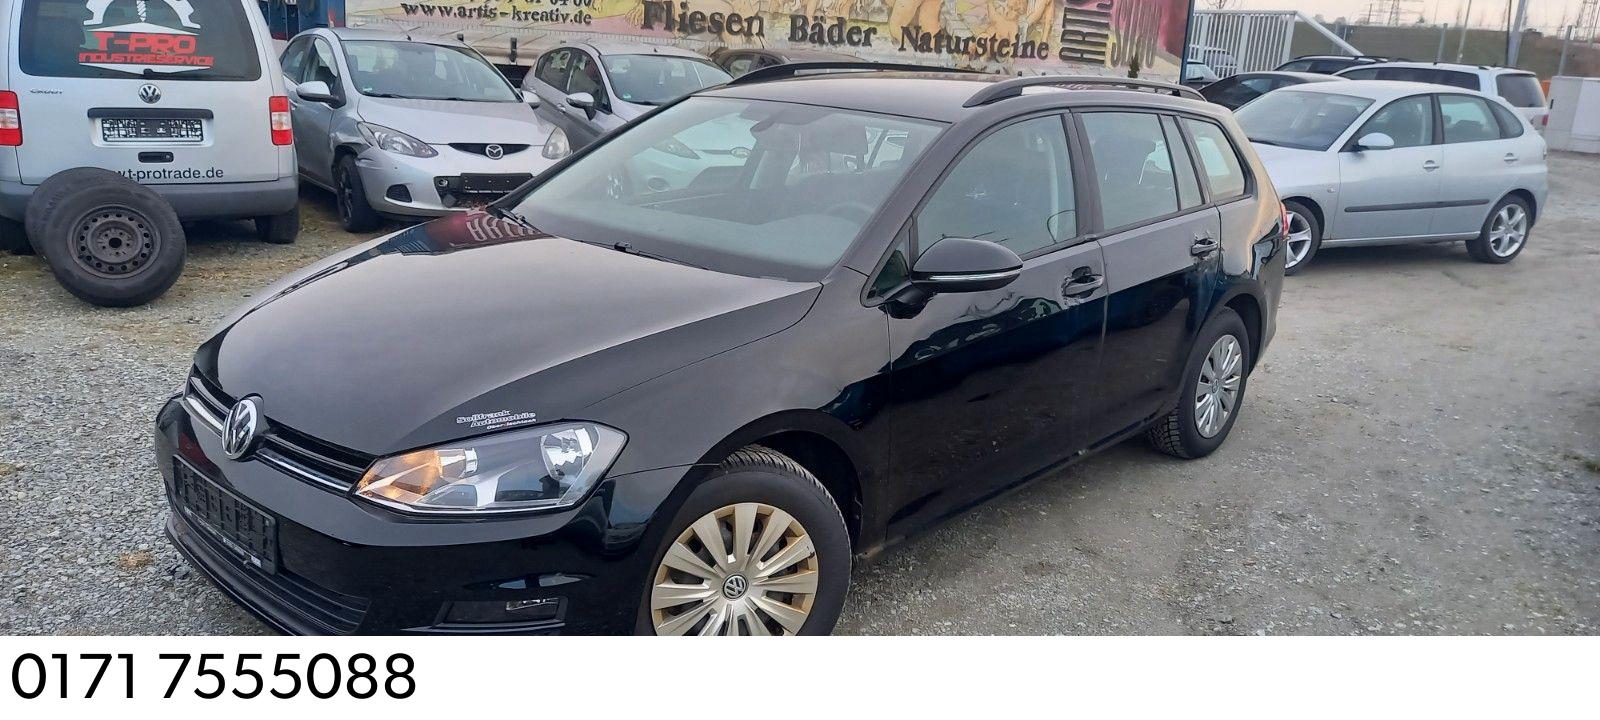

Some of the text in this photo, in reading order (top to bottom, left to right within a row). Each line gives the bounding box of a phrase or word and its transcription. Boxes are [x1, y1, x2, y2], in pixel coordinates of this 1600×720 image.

[641, 0, 1050, 61] Fliesen Bäder Natursteine
[93, 31, 197, 54] T-PRO
[79, 52, 214, 67] INDUSTRIESERVICE
